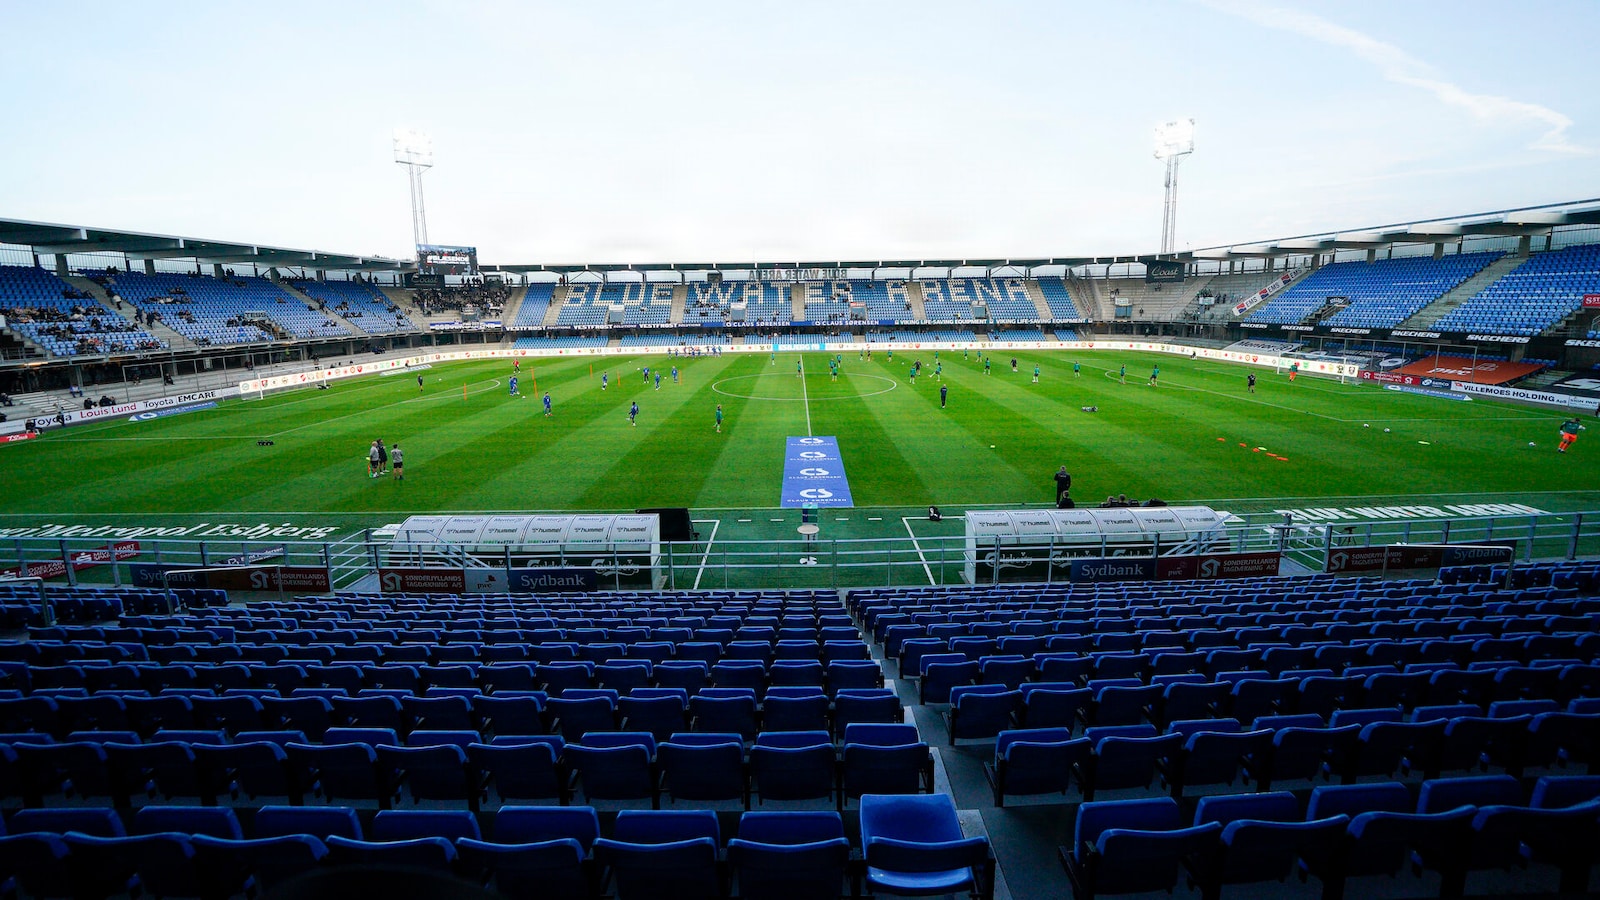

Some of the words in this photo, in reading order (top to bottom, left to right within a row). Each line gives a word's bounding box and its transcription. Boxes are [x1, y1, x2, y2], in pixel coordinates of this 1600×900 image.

[1151, 265, 1179, 276] Coast
[563, 283, 674, 306] BLUE
[694, 281, 853, 304] WATER
[886, 278, 1032, 302] ARENA
[1268, 282, 1280, 293] EMS
[1246, 296, 1258, 307] EMS
[1330, 327, 1371, 335] SKECHERS
[1391, 330, 1441, 338] SKECHERS
[1466, 334, 1531, 344] SKECHERS
[177, 391, 217, 403] EMCARE
[1464, 384, 1511, 396] VILLEMOES
[1512, 391, 1555, 402] HOLDING
[143, 397, 174, 409] Toyota
[80, 407, 109, 419] Louis
[111, 403, 137, 414] Lund
[32, 414, 72, 427] Toyoa
[194, 523, 340, 540] Esbjerg
[1453, 547, 1507, 561] Sydbank
[139, 568, 197, 585] Sydbank
[1081, 564, 1144, 579] Sydbank
[521, 575, 586, 589] Sydbank
